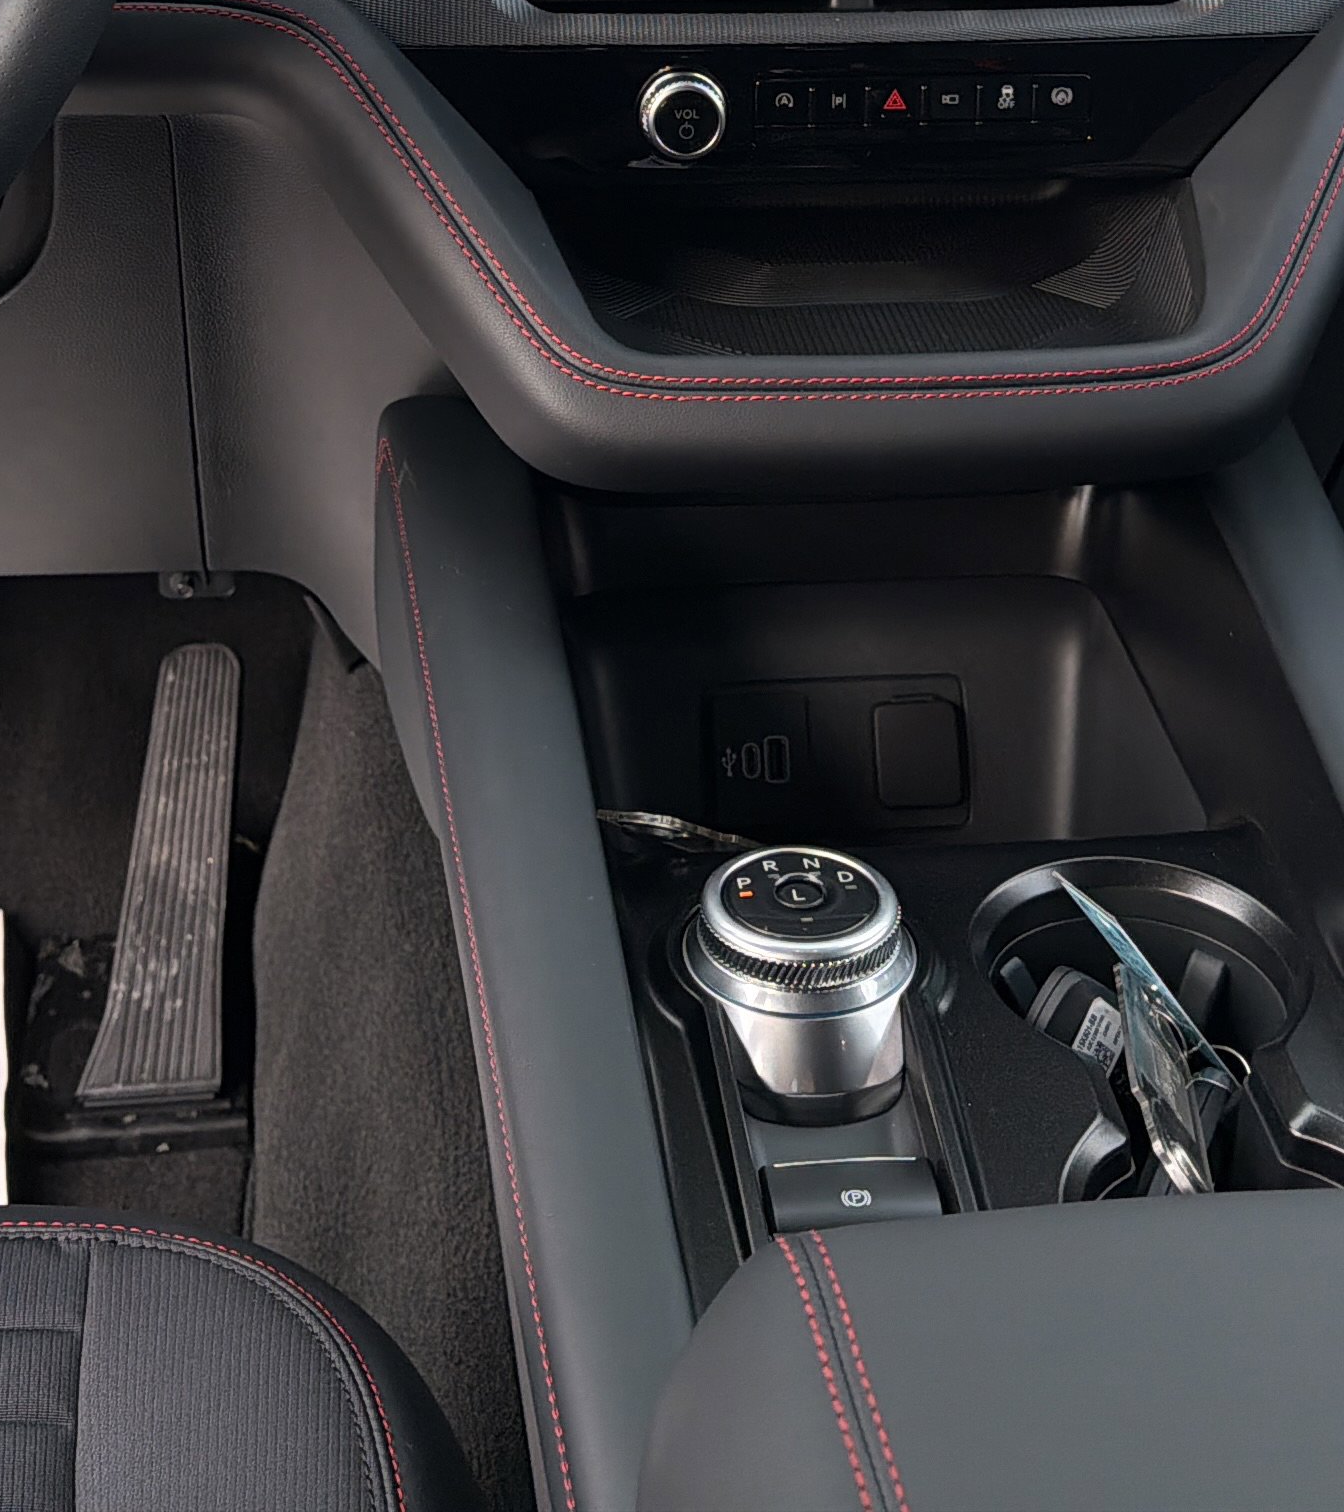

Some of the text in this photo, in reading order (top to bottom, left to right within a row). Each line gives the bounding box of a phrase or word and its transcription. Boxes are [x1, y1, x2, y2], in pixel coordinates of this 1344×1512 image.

[997, 100, 1016, 110] OFF
[674, 109, 700, 120] VOL
[762, 860, 779, 872] R
[802, 857, 821, 870] N
[736, 876, 752, 889] P
[837, 870, 854, 883] D
[791, 888, 806, 902] L
